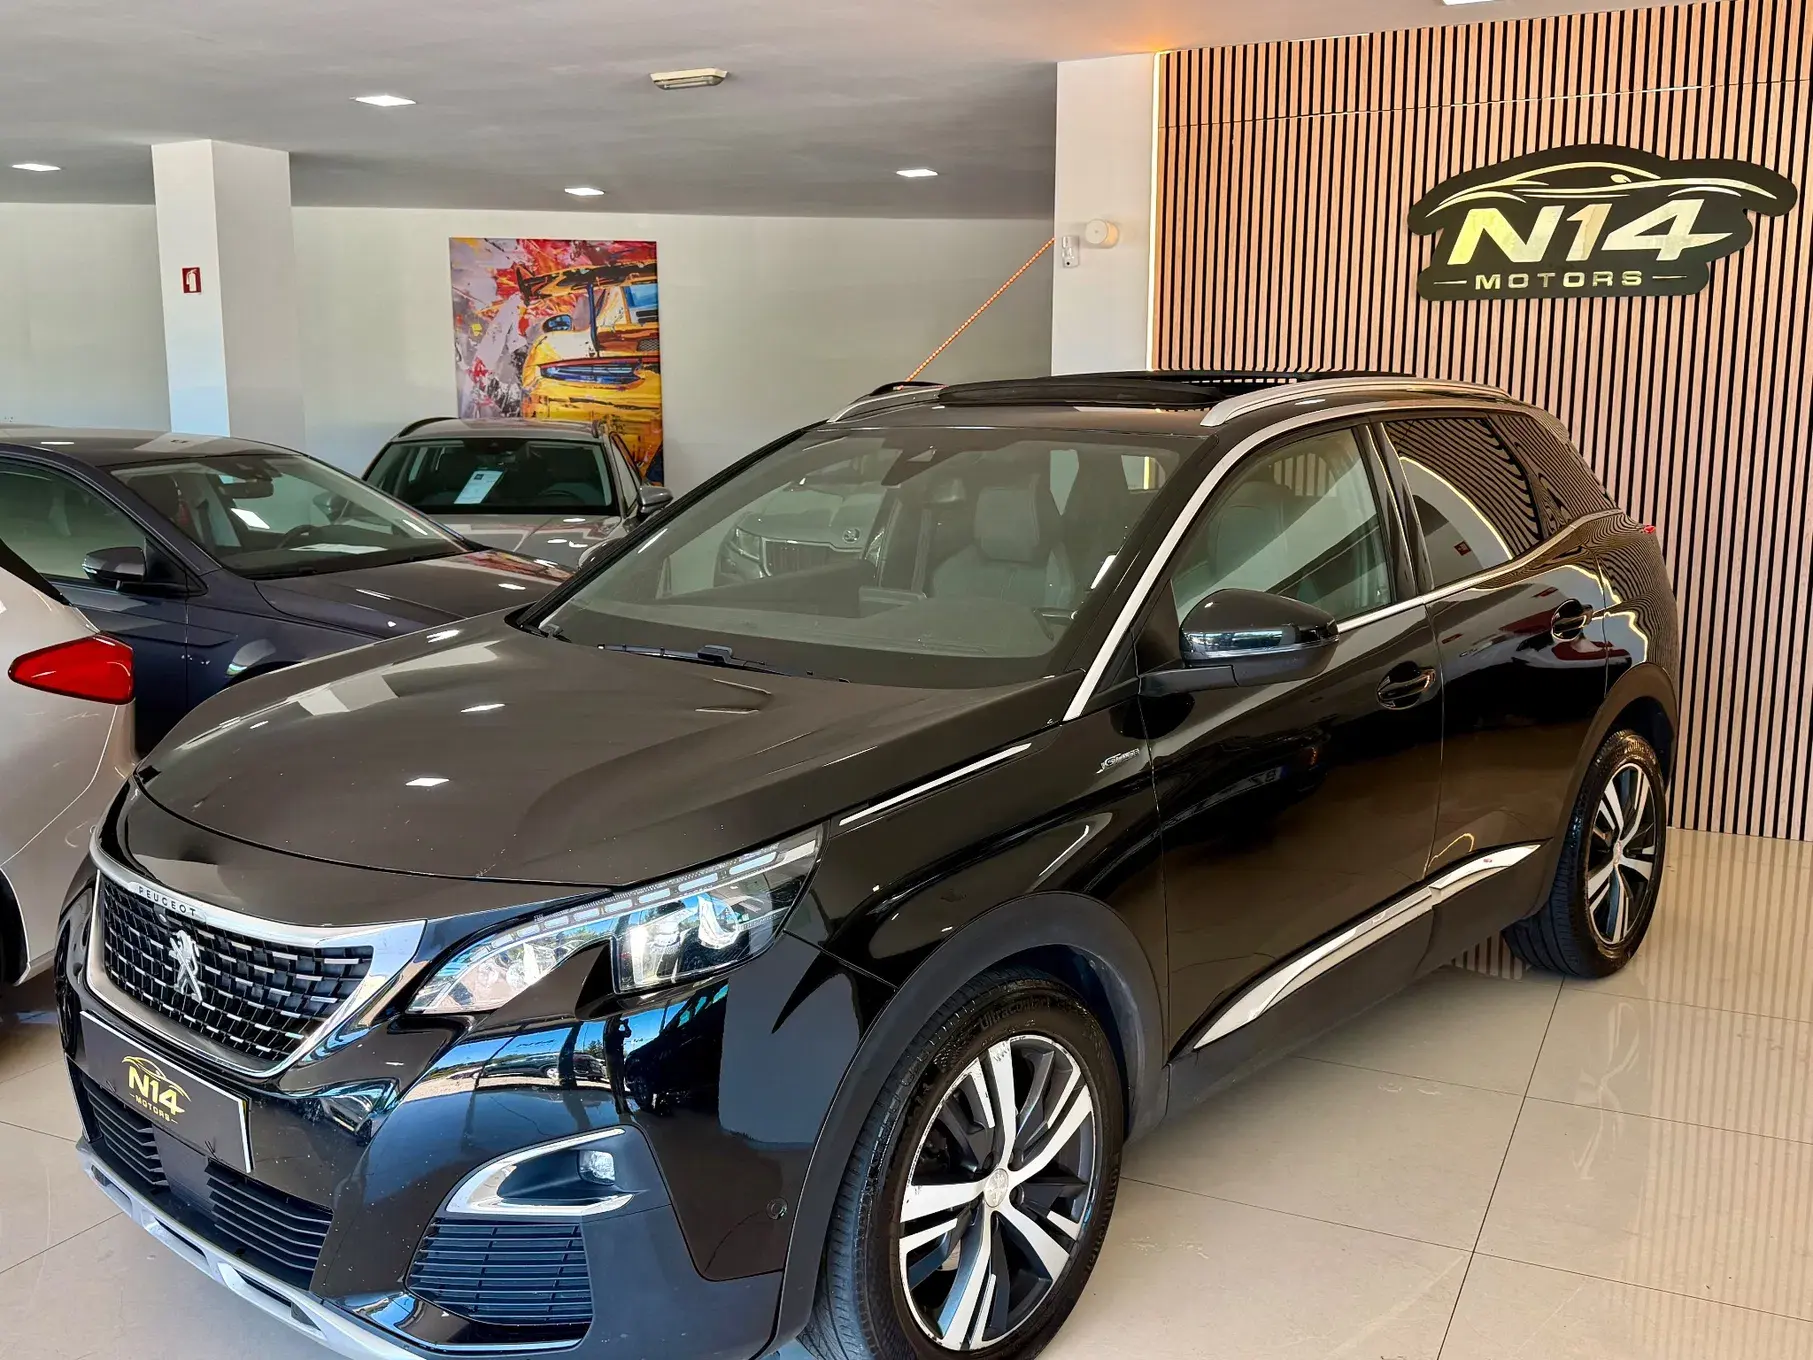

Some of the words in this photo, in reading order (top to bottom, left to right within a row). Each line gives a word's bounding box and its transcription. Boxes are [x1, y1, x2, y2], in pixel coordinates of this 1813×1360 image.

[1447, 199, 1734, 266] N14
[1475, 270, 1644, 290] MOTORS
[138, 885, 197, 917] PEUGEOT
[128, 1065, 186, 1116] N14
[134, 1094, 171, 1122] MOTORS
